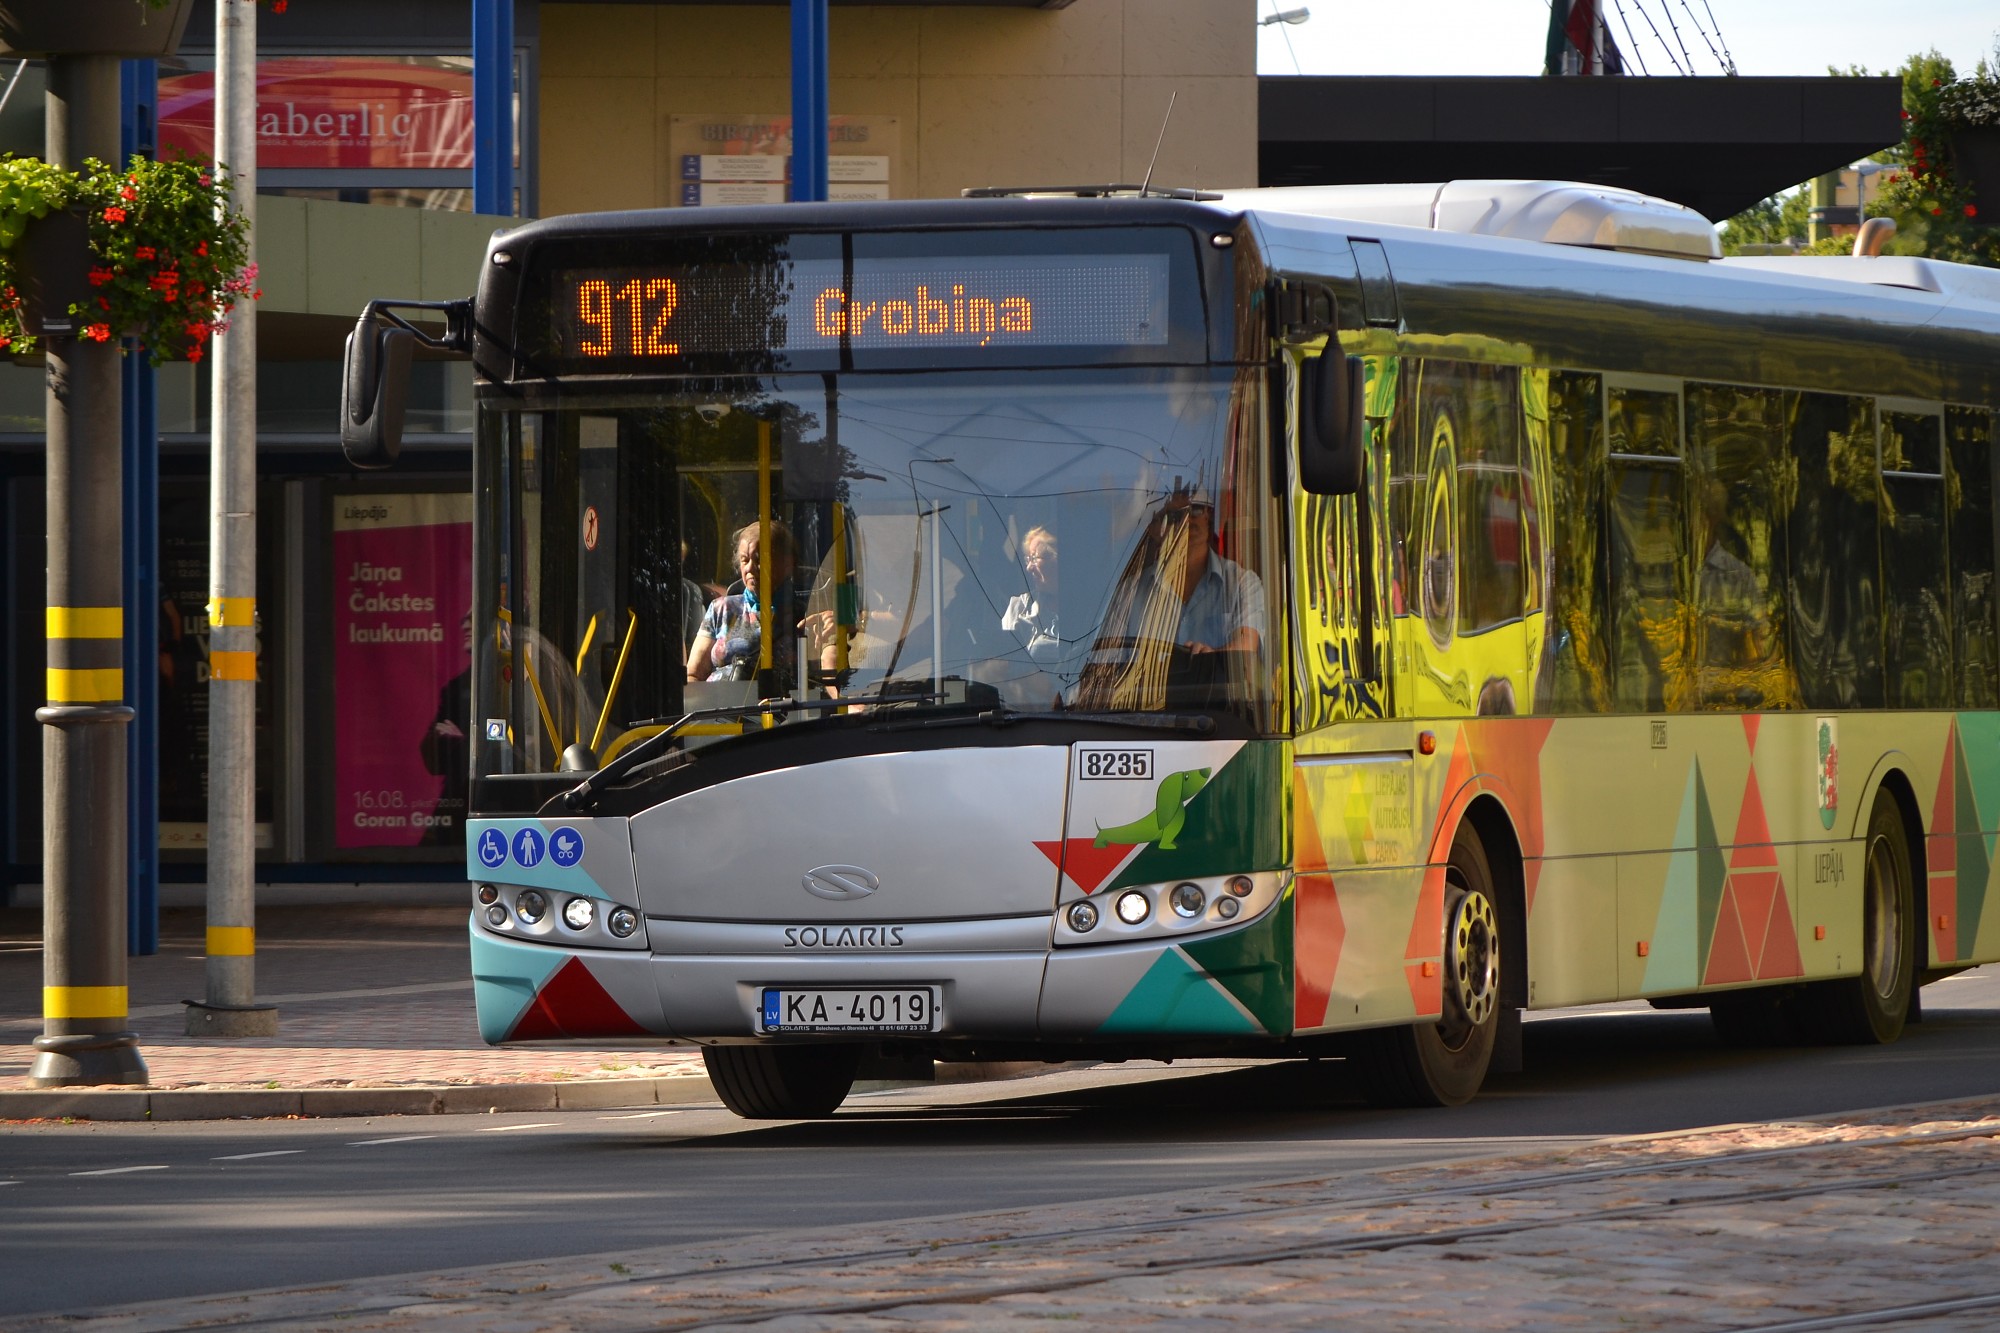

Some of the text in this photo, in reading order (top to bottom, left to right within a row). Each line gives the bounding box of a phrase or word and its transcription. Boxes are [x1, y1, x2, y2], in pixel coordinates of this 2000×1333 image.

[256, 102, 411, 137] aberlic
[580, 279, 1032, 356] 912 Grobiņa
[344, 505, 388, 521] Liepāja
[348, 561, 402, 587] Jāņa
[349, 587, 435, 612] Čakstes
[350, 622, 444, 643] laukumā
[1087, 752, 1147, 776] 8235
[353, 790, 408, 808] 16.08.
[354, 810, 453, 828] Goran Gora
[1375, 840, 1399, 863] PARKS
[1815, 848, 1844, 888] LIEPĀJA
[784, 926, 904, 948] SOLARIS
[766, 1011, 778, 1020] LV
[787, 994, 924, 1022] KA-4019
